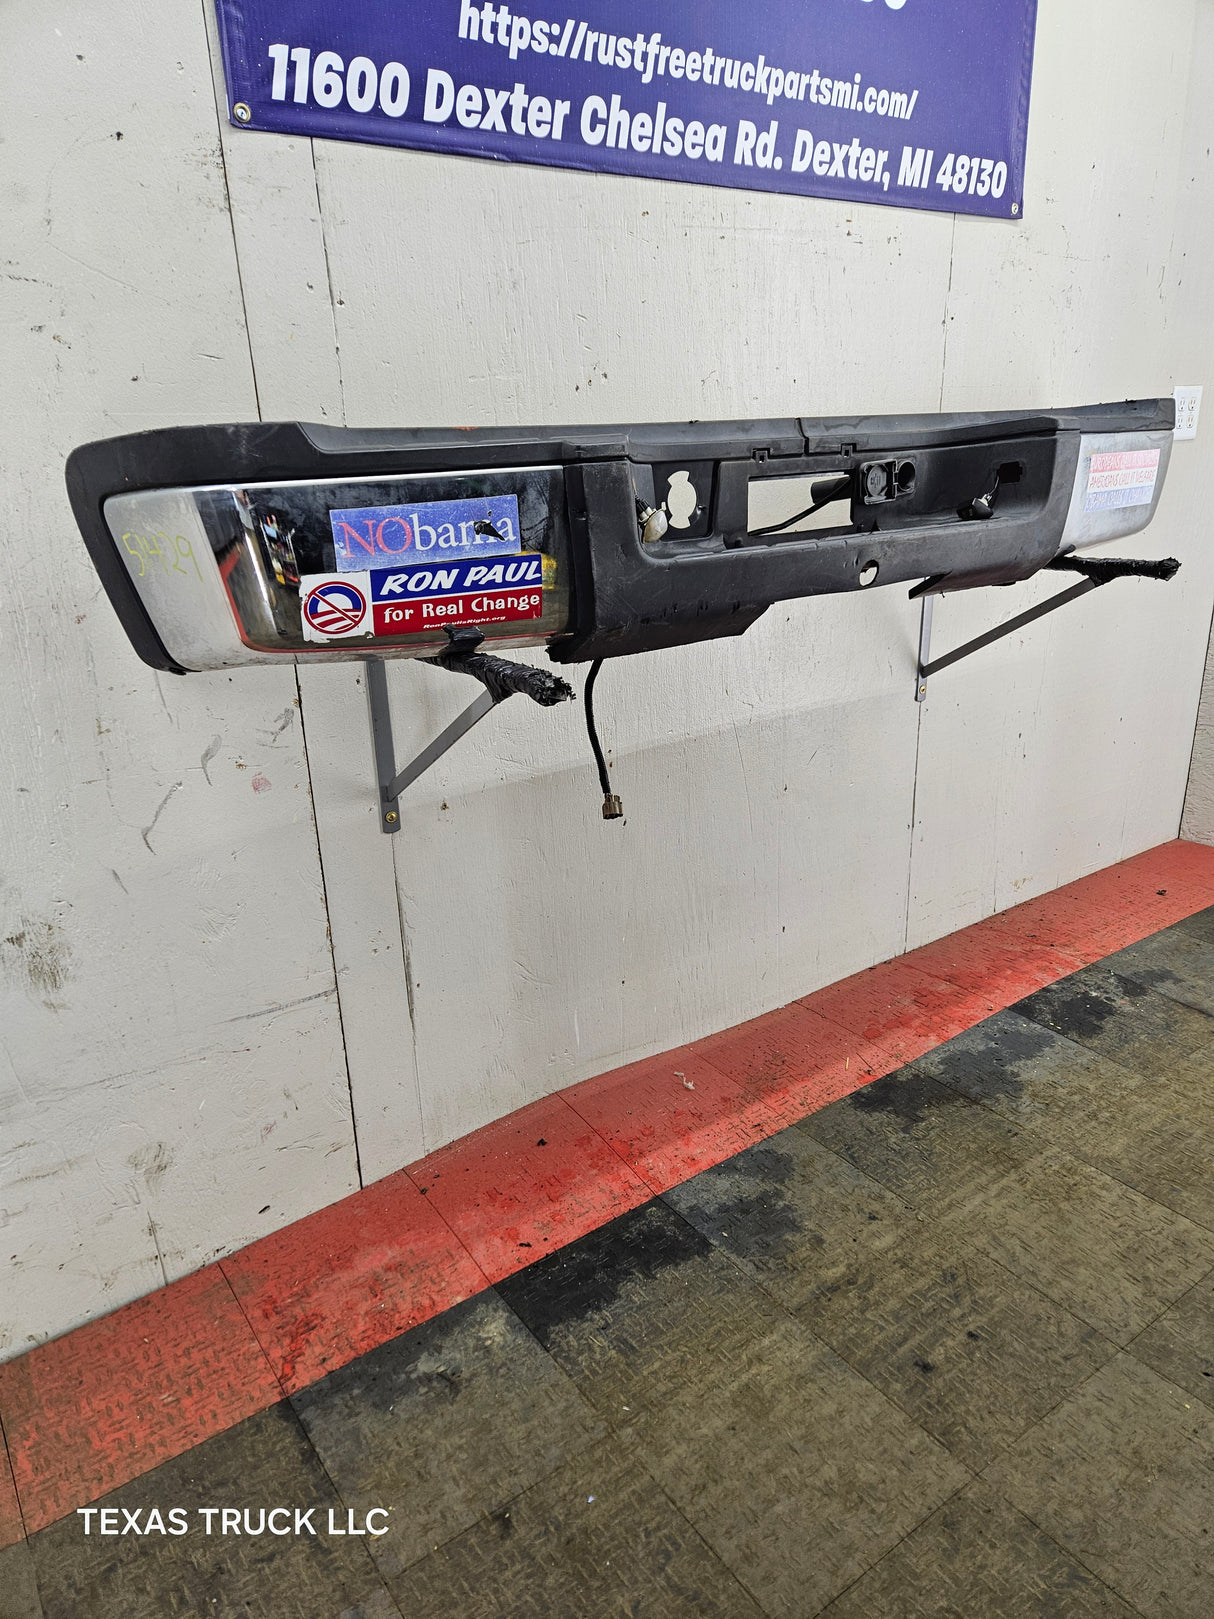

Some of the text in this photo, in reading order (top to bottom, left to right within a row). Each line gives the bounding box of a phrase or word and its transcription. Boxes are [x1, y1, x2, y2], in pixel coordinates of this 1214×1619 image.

[458, 0, 919, 120] https://rustfreetruckpartsmi.com/
[268, 43, 1008, 199] 11600 Dexter Chelsea Rd. Dexter, MI 48130
[379, 560, 542, 596] RON PAUL
[383, 593, 541, 624] for Real Change
